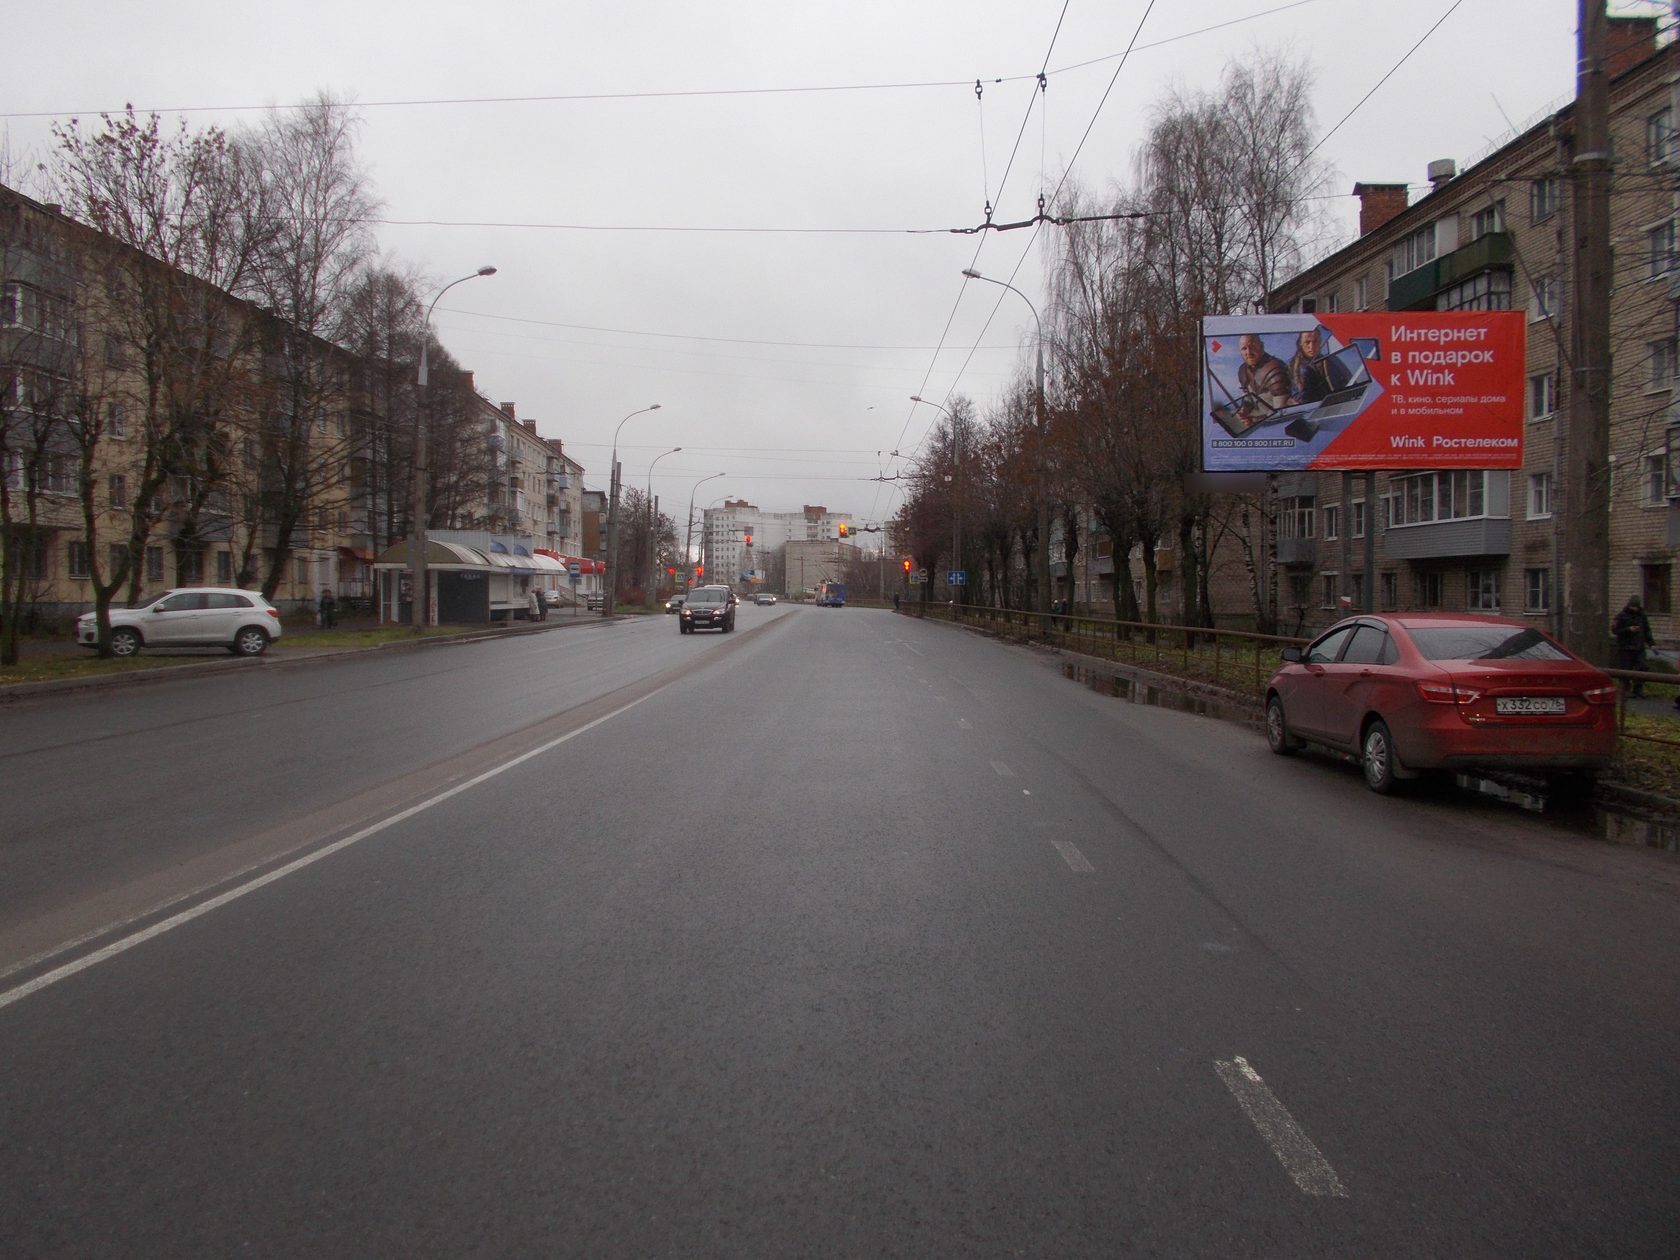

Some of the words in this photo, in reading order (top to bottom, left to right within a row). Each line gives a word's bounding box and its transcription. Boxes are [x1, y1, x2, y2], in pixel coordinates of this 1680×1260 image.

[1391, 325, 1487, 345] Интернет
[1391, 351, 1402, 364] в
[1408, 350, 1494, 367] подарок
[1391, 373, 1401, 386] к
[1407, 369, 1455, 386] Wink
[1436, 395, 1478, 405] сериалы
[1480, 395, 1506, 404] дома
[1408, 406, 1463, 415] мобильном
[1390, 435, 1425, 448] Wink
[1433, 435, 1519, 448] Ростелеком
